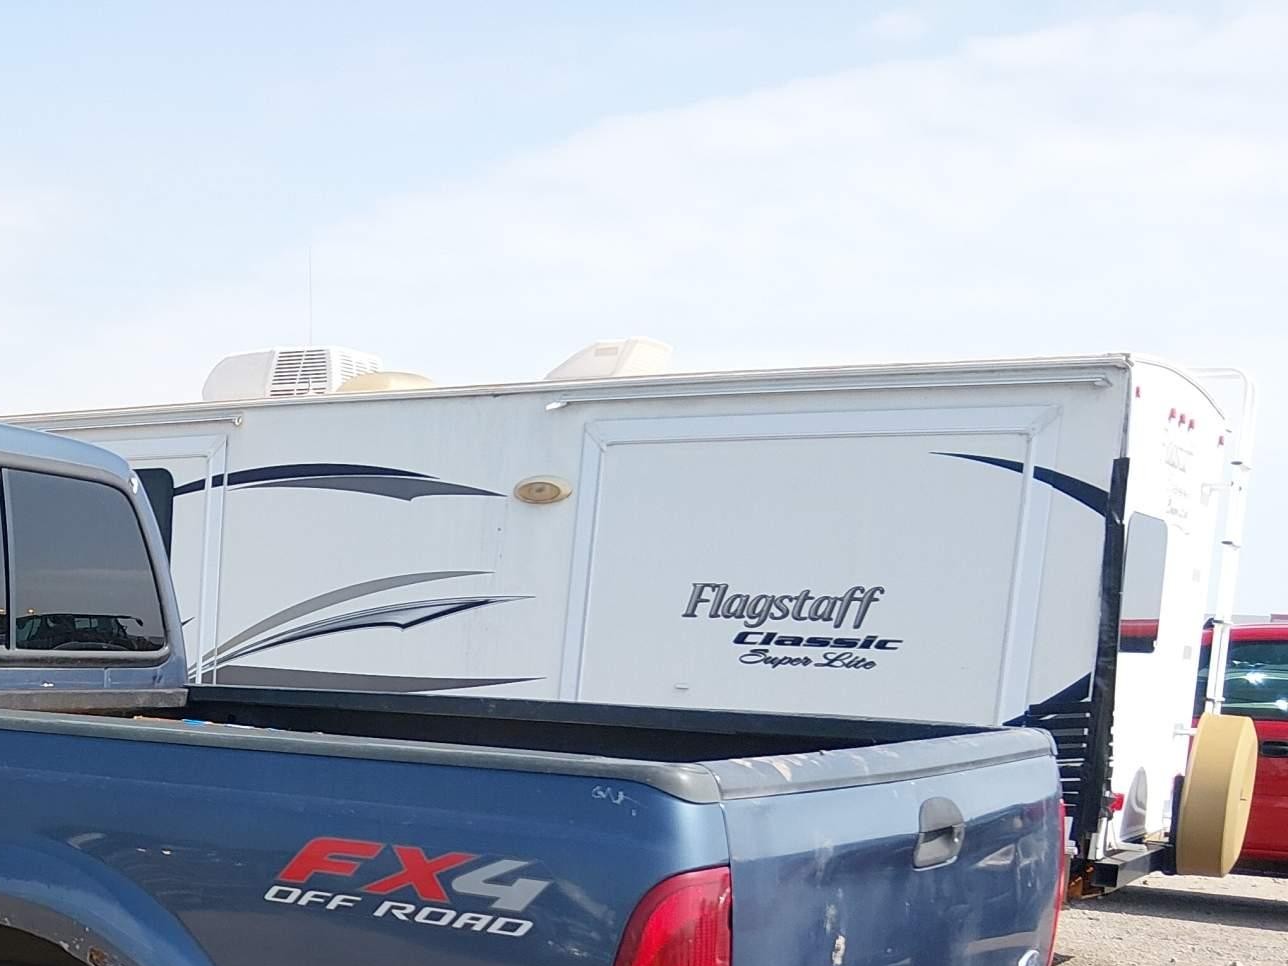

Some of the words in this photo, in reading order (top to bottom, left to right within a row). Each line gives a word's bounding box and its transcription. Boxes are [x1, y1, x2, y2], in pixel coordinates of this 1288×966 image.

[681, 582, 885, 630] Flagstaff
[732, 631, 904, 651] Classic
[739, 649, 812, 669] Super
[814, 652, 876, 670] Lite
[277, 836, 551, 913] FX4
[264, 885, 361, 910] OFF
[373, 900, 534, 937] ROAD
